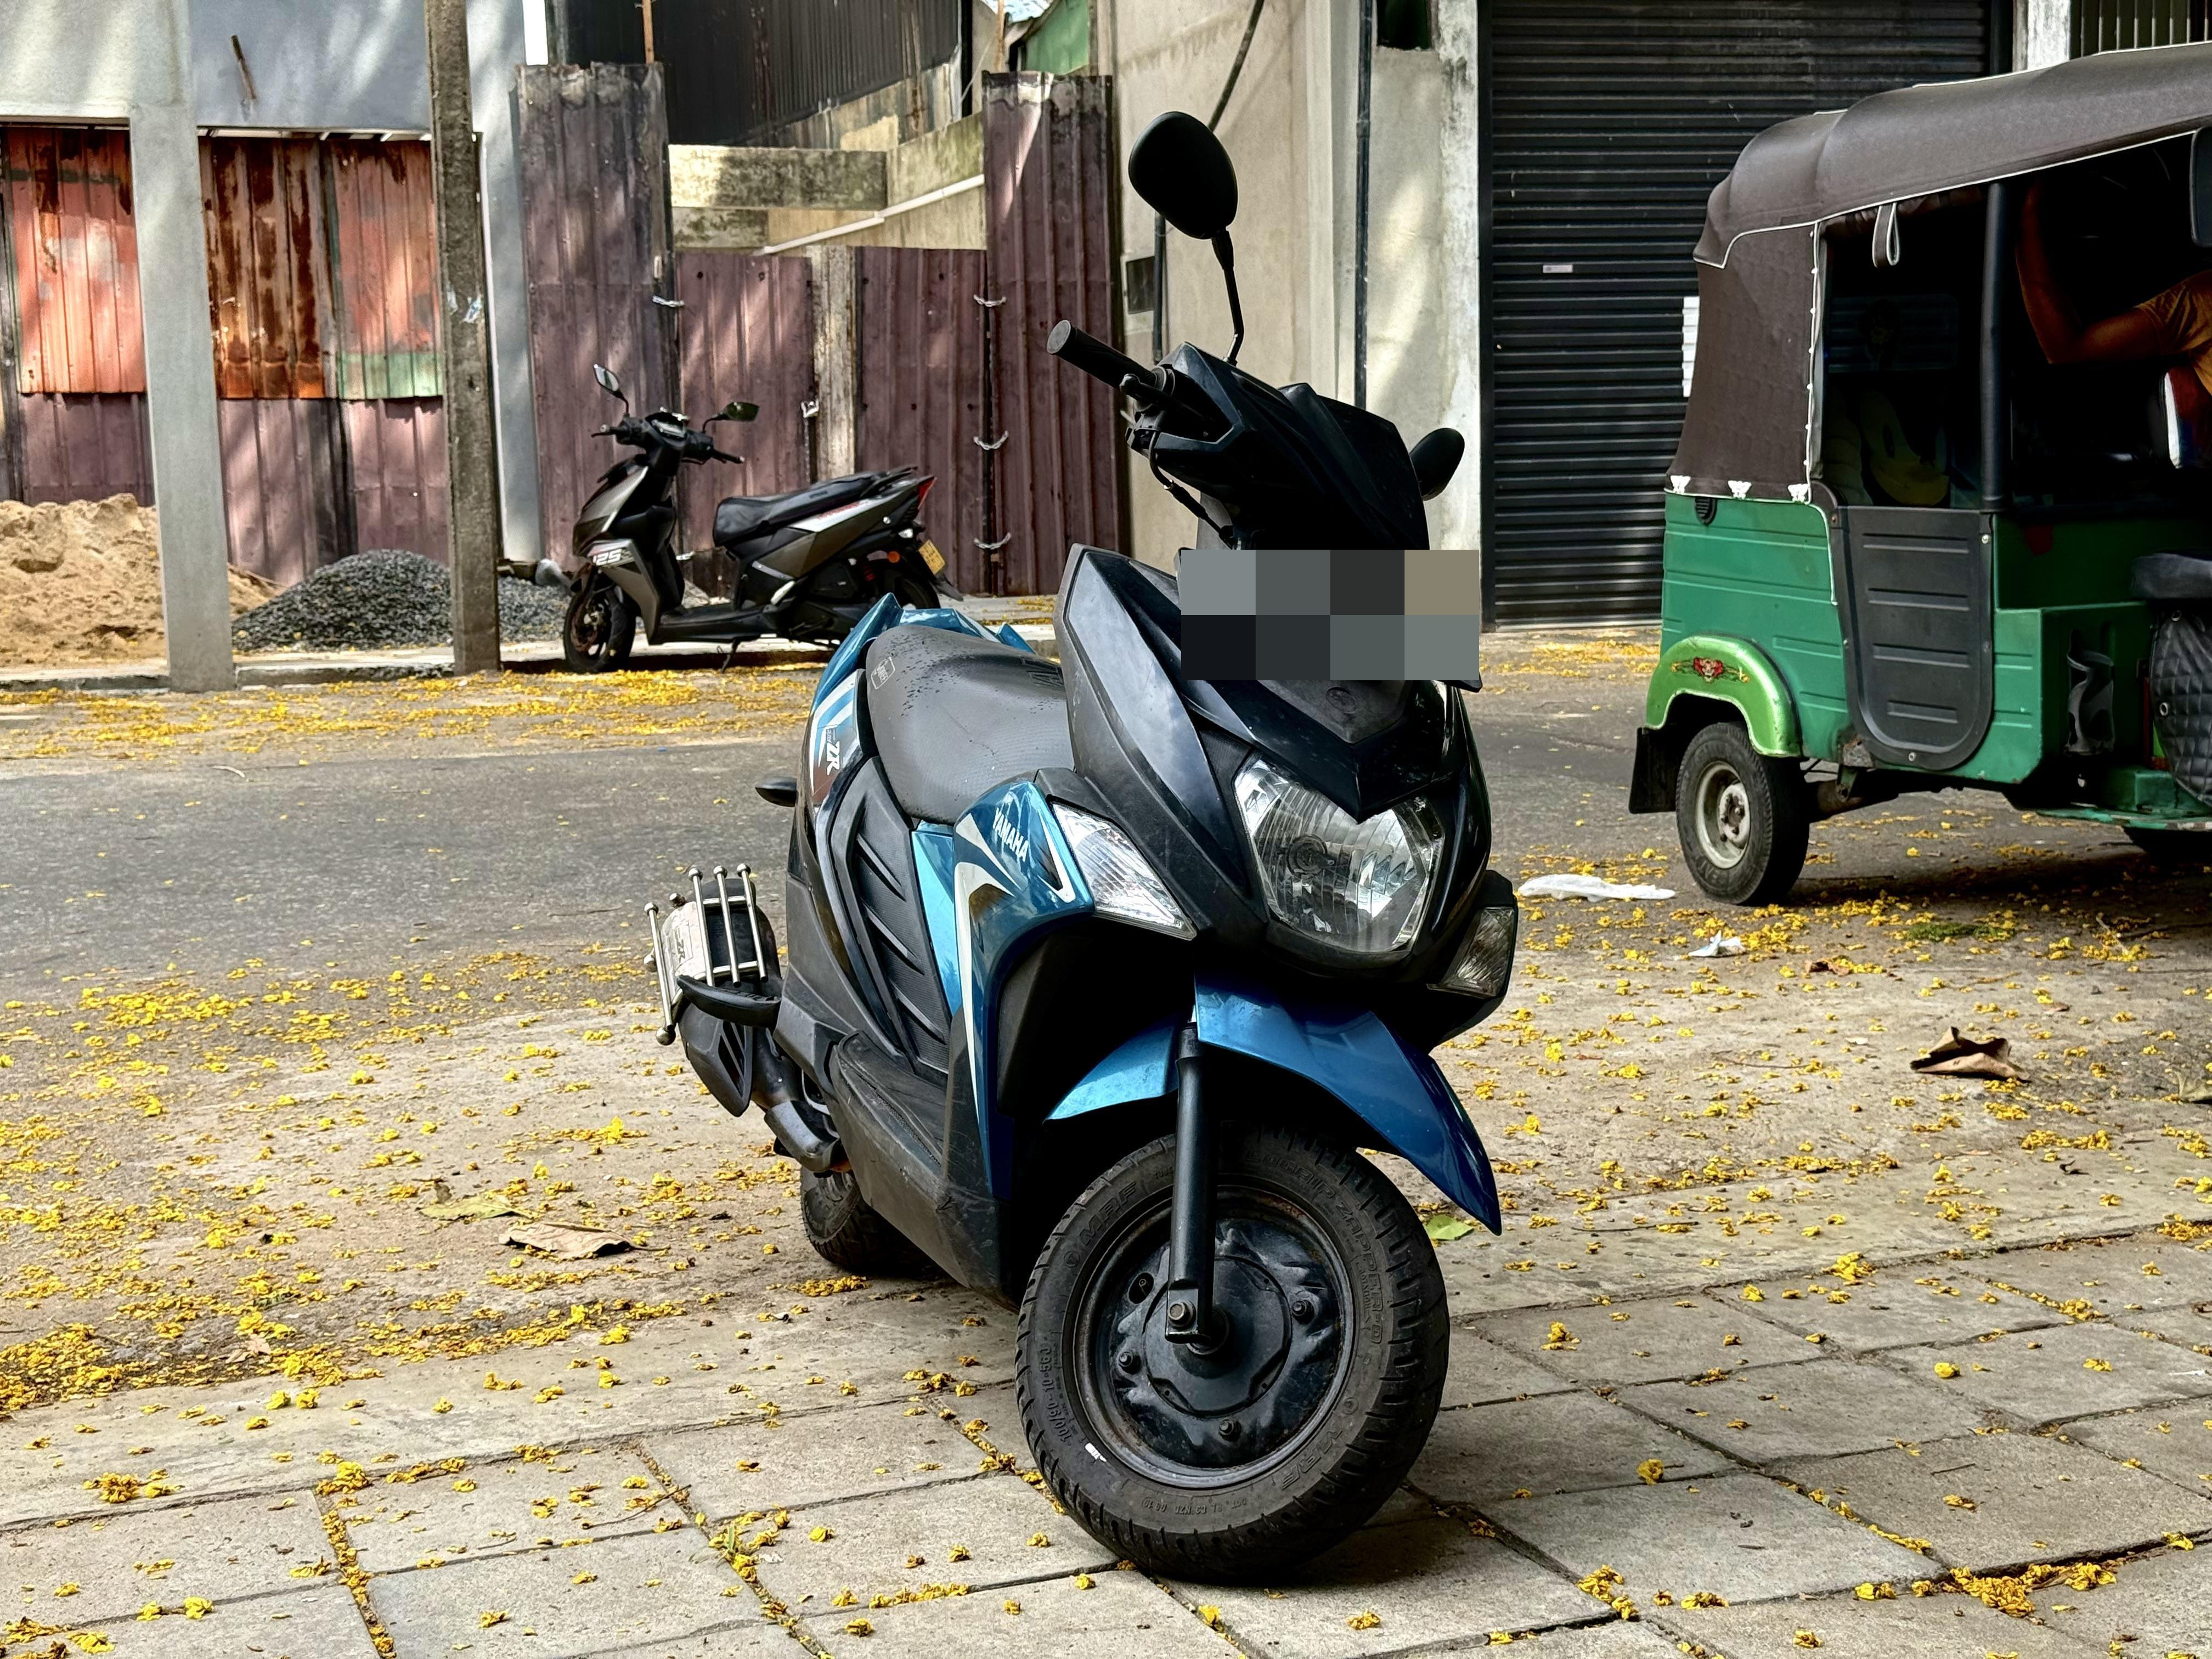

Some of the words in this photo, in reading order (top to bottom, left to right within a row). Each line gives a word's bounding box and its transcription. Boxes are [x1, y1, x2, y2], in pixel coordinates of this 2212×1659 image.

[593, 549, 622, 566] 125
[827, 741, 840, 776] ZR
[992, 807, 1029, 862] YAMAHA
[1079, 1181, 1137, 1246] MRF
[1280, 1421, 1344, 1491] MRF
